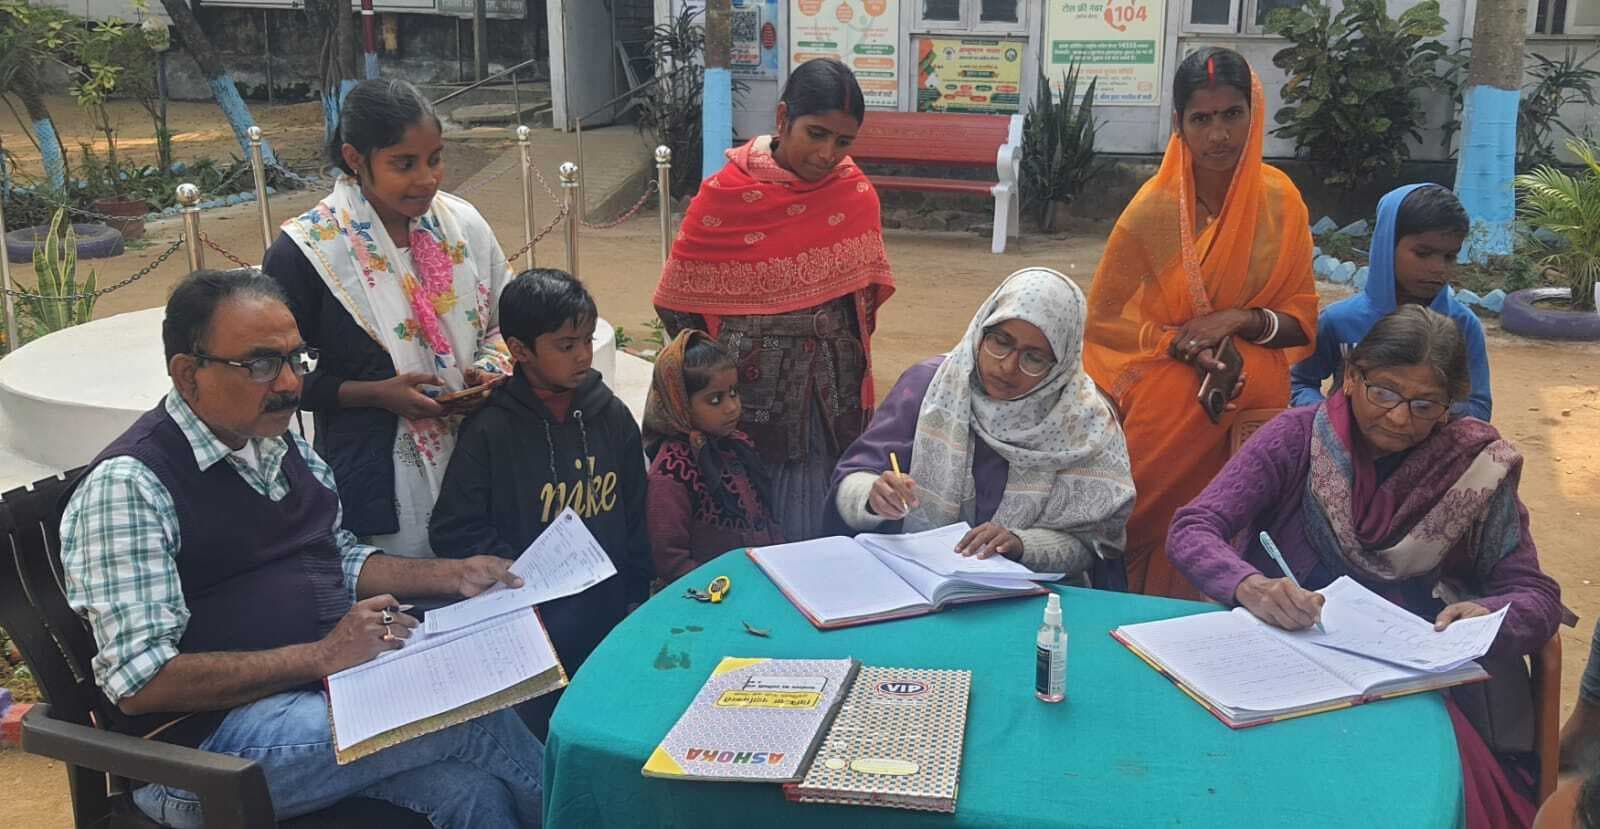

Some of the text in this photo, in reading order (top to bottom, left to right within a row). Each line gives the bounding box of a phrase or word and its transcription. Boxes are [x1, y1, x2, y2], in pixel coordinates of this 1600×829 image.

[1115, 6, 1148, 22] 104
[540, 455, 617, 522] nike
[886, 684, 922, 693] VIP
[686, 747, 785, 765] ASHOKA
